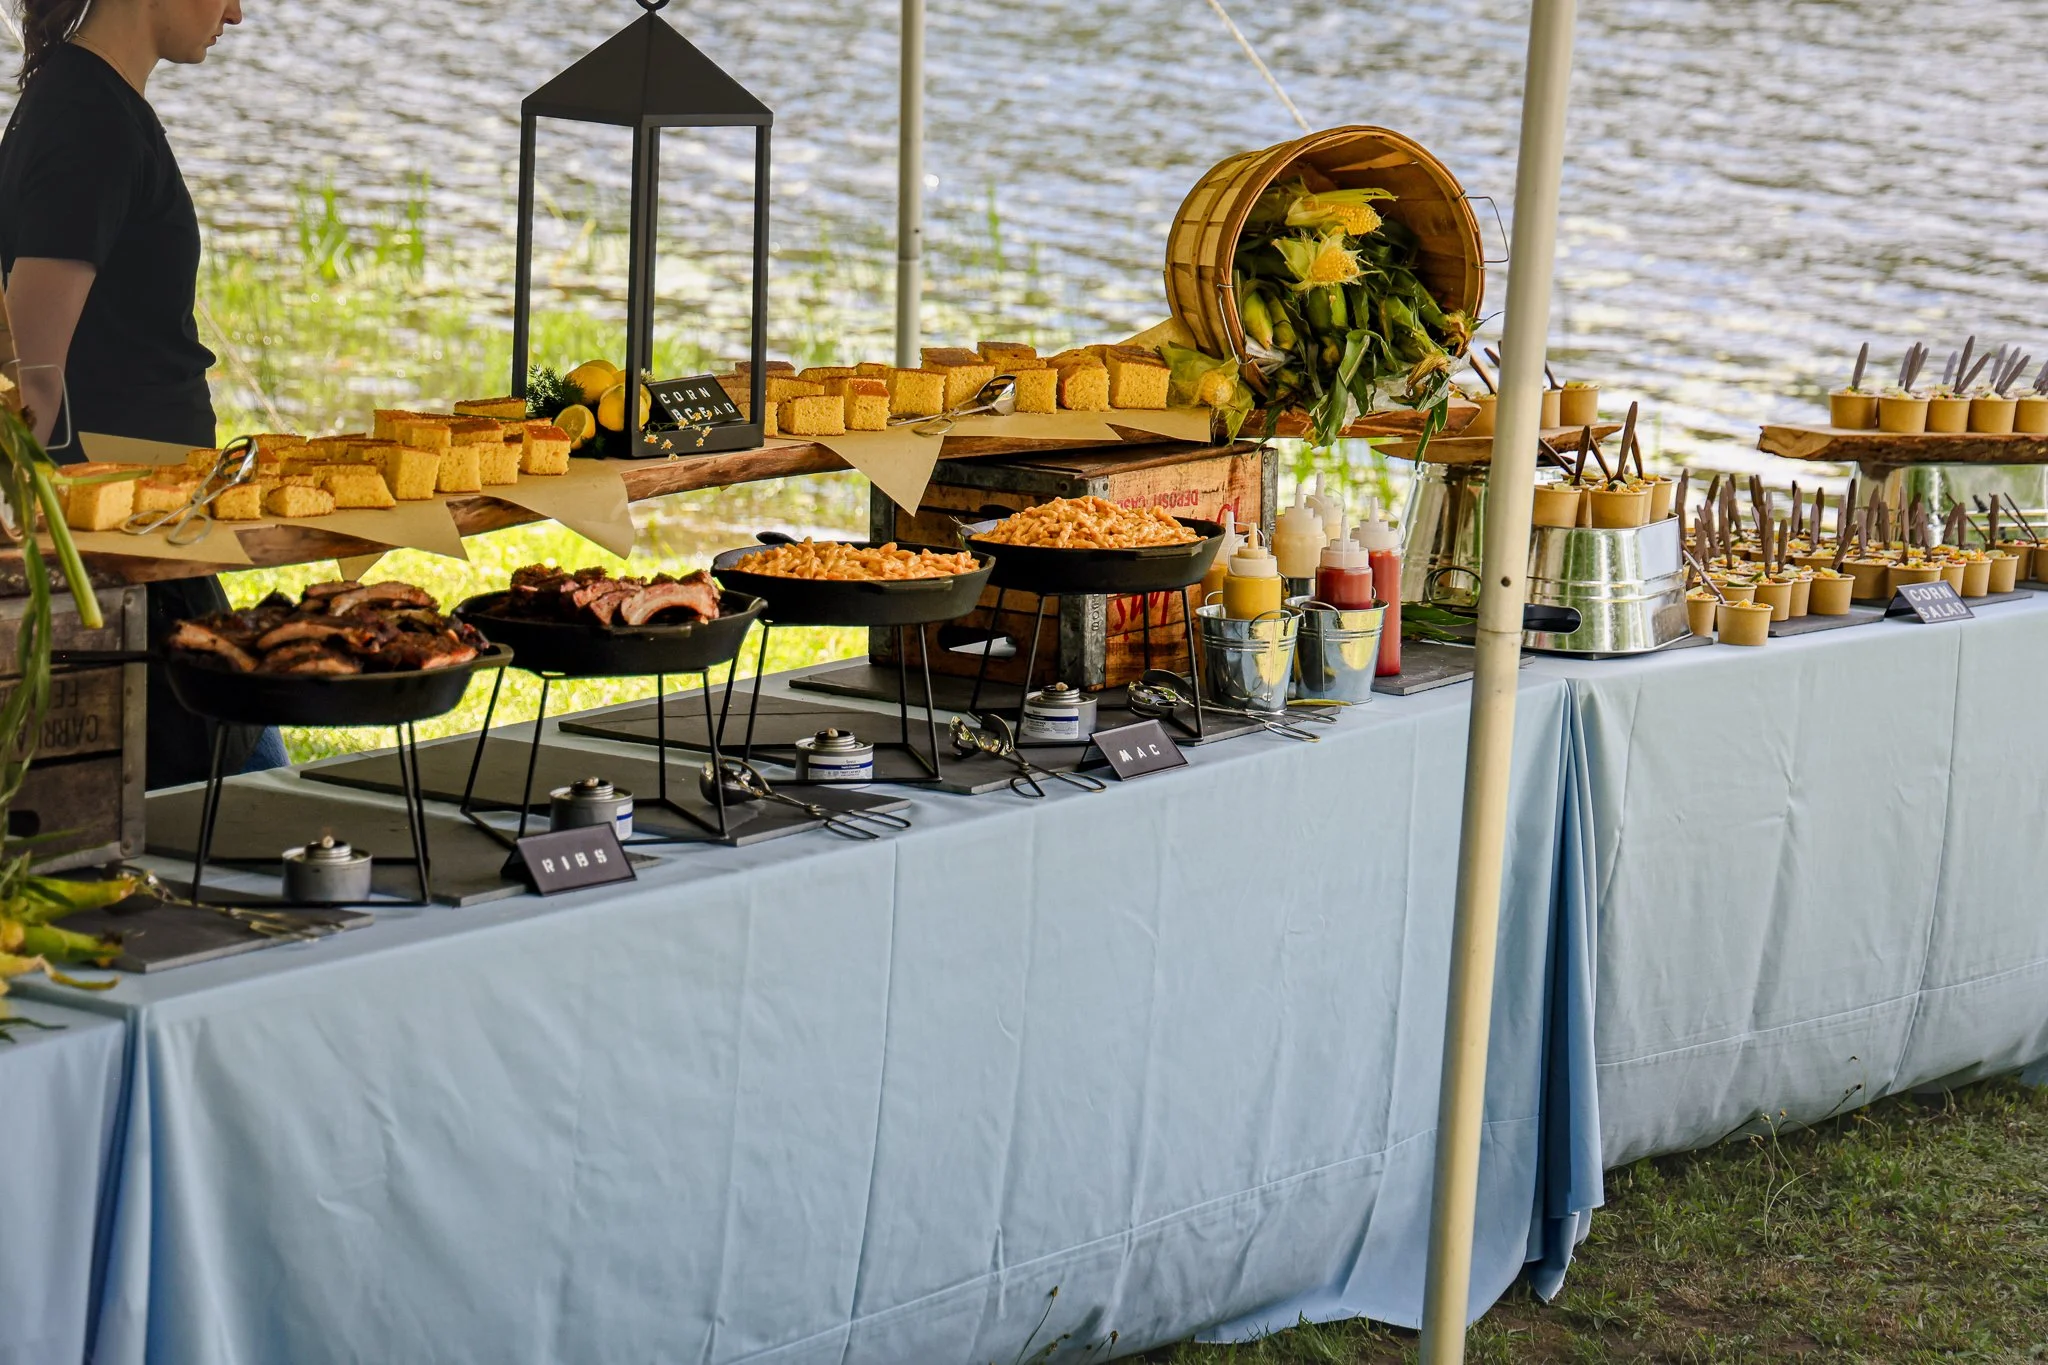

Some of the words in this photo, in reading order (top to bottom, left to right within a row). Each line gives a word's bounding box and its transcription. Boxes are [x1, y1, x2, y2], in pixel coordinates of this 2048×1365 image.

[659, 387, 711, 404] CORN
[1909, 585, 1952, 602] CORN
[1917, 602, 1967, 619] SALAD
[1119, 743, 1161, 762] MAC
[542, 848, 608, 873] RIBS
